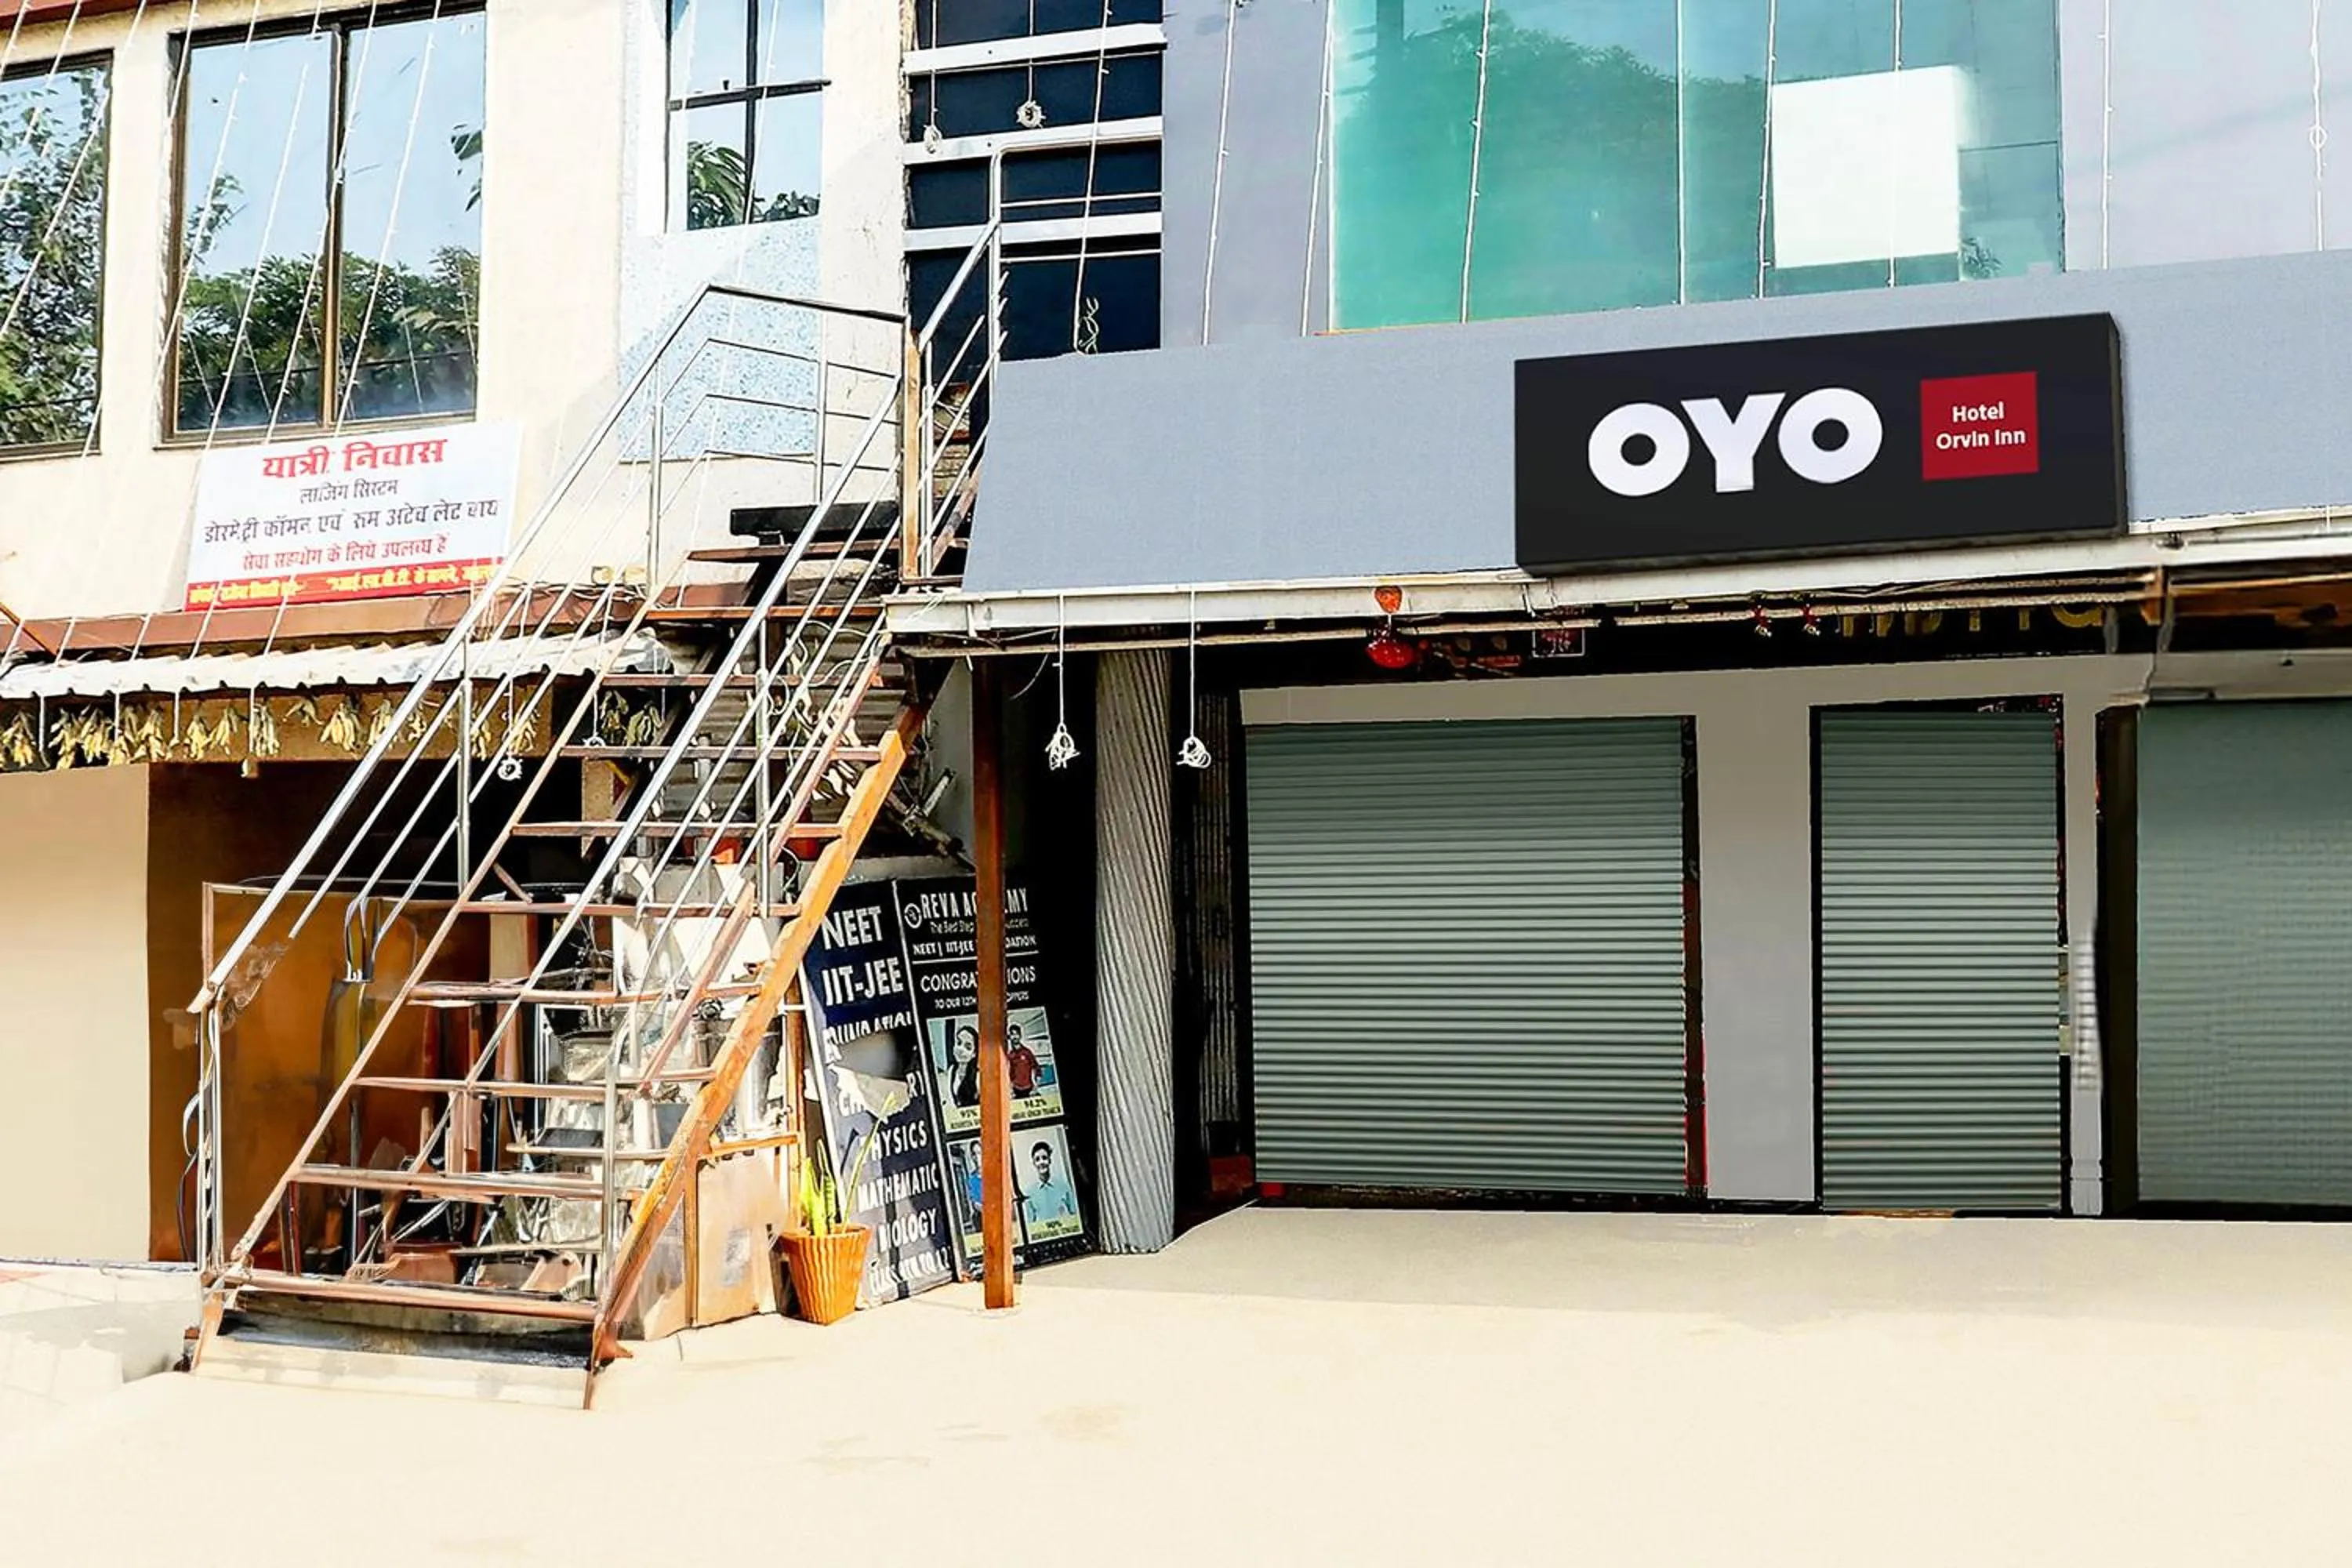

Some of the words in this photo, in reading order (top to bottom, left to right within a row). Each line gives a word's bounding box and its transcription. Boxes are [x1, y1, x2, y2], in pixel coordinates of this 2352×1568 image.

[1951, 401, 2005, 424] Hotel
[1588, 387, 1883, 497] OYO
[1936, 430, 1990, 451] Orvin
[1994, 428, 2026, 447] Inn
[263, 445, 330, 478] यात्री
[342, 438, 448, 471] निवास
[327, 543, 343, 563] के
[920, 891, 960, 920] REVA
[822, 905, 884, 951] NEET
[912, 942, 937, 956] NEET
[822, 956, 905, 1007] IIT-JEE
[877, 1207, 938, 1254] BIOLOGY
